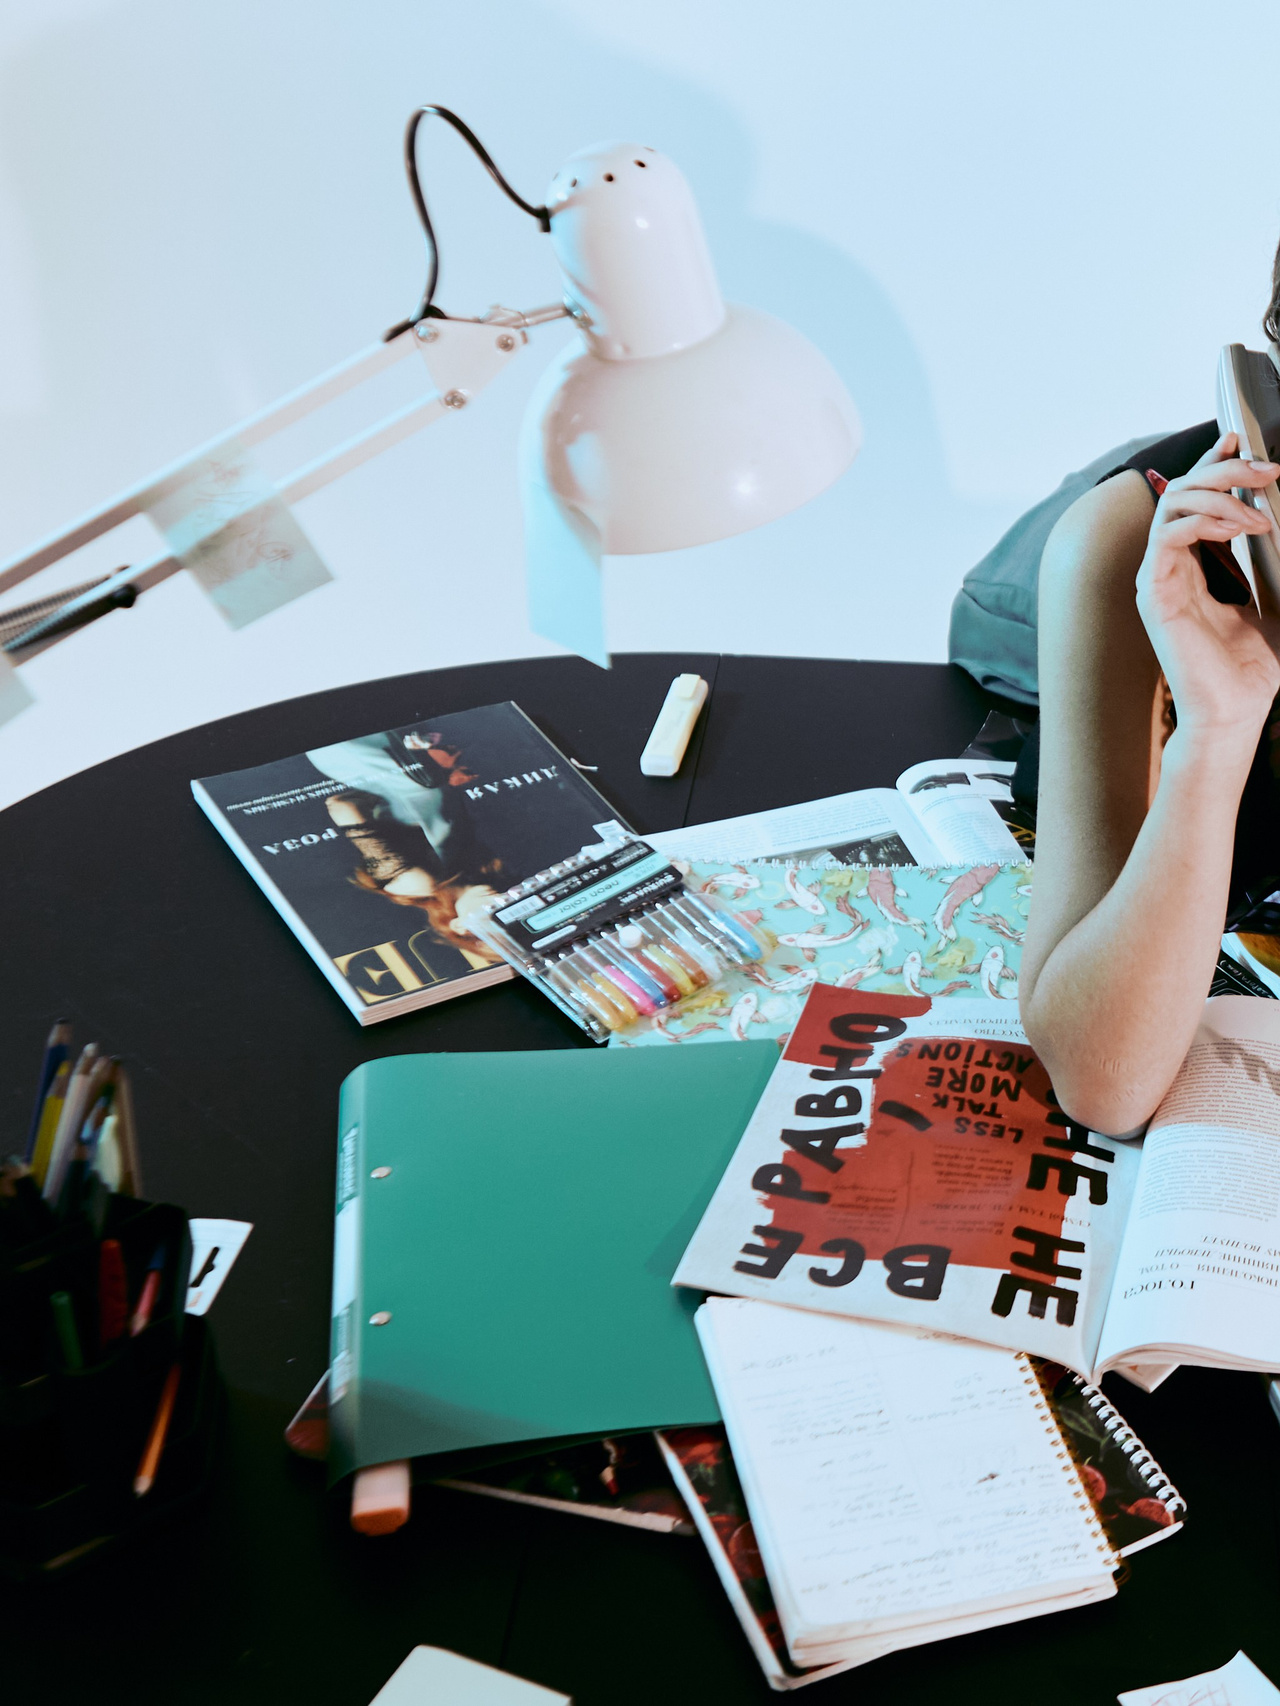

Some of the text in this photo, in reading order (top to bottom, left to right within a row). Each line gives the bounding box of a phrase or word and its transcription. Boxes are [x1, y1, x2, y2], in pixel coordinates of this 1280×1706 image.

[462, 762, 559, 802] ДИКАЯ
[260, 824, 338, 857] РОЗА
[557, 894, 588, 915] color
[588, 877, 620, 899] neon
[973, 1028, 1027, 1037] КУССТВО
[896, 1040, 1035, 1075] ACTIONS
[924, 1066, 1022, 1104] MORE
[750, 1012, 910, 1207] РАВНО
[931, 1093, 1003, 1119] TALK
[953, 1116, 1024, 1145] LESS
[1026, 1086, 1116, 1206] НЕ
[732, 1224, 952, 1301] ВСЕ
[1152, 1247, 1212, 1259] ДЕВОЧКИ
[991, 1225, 1087, 1328] НЕ
[1194, 1263, 1277, 1286] ПОКОЛЕНИЯ
